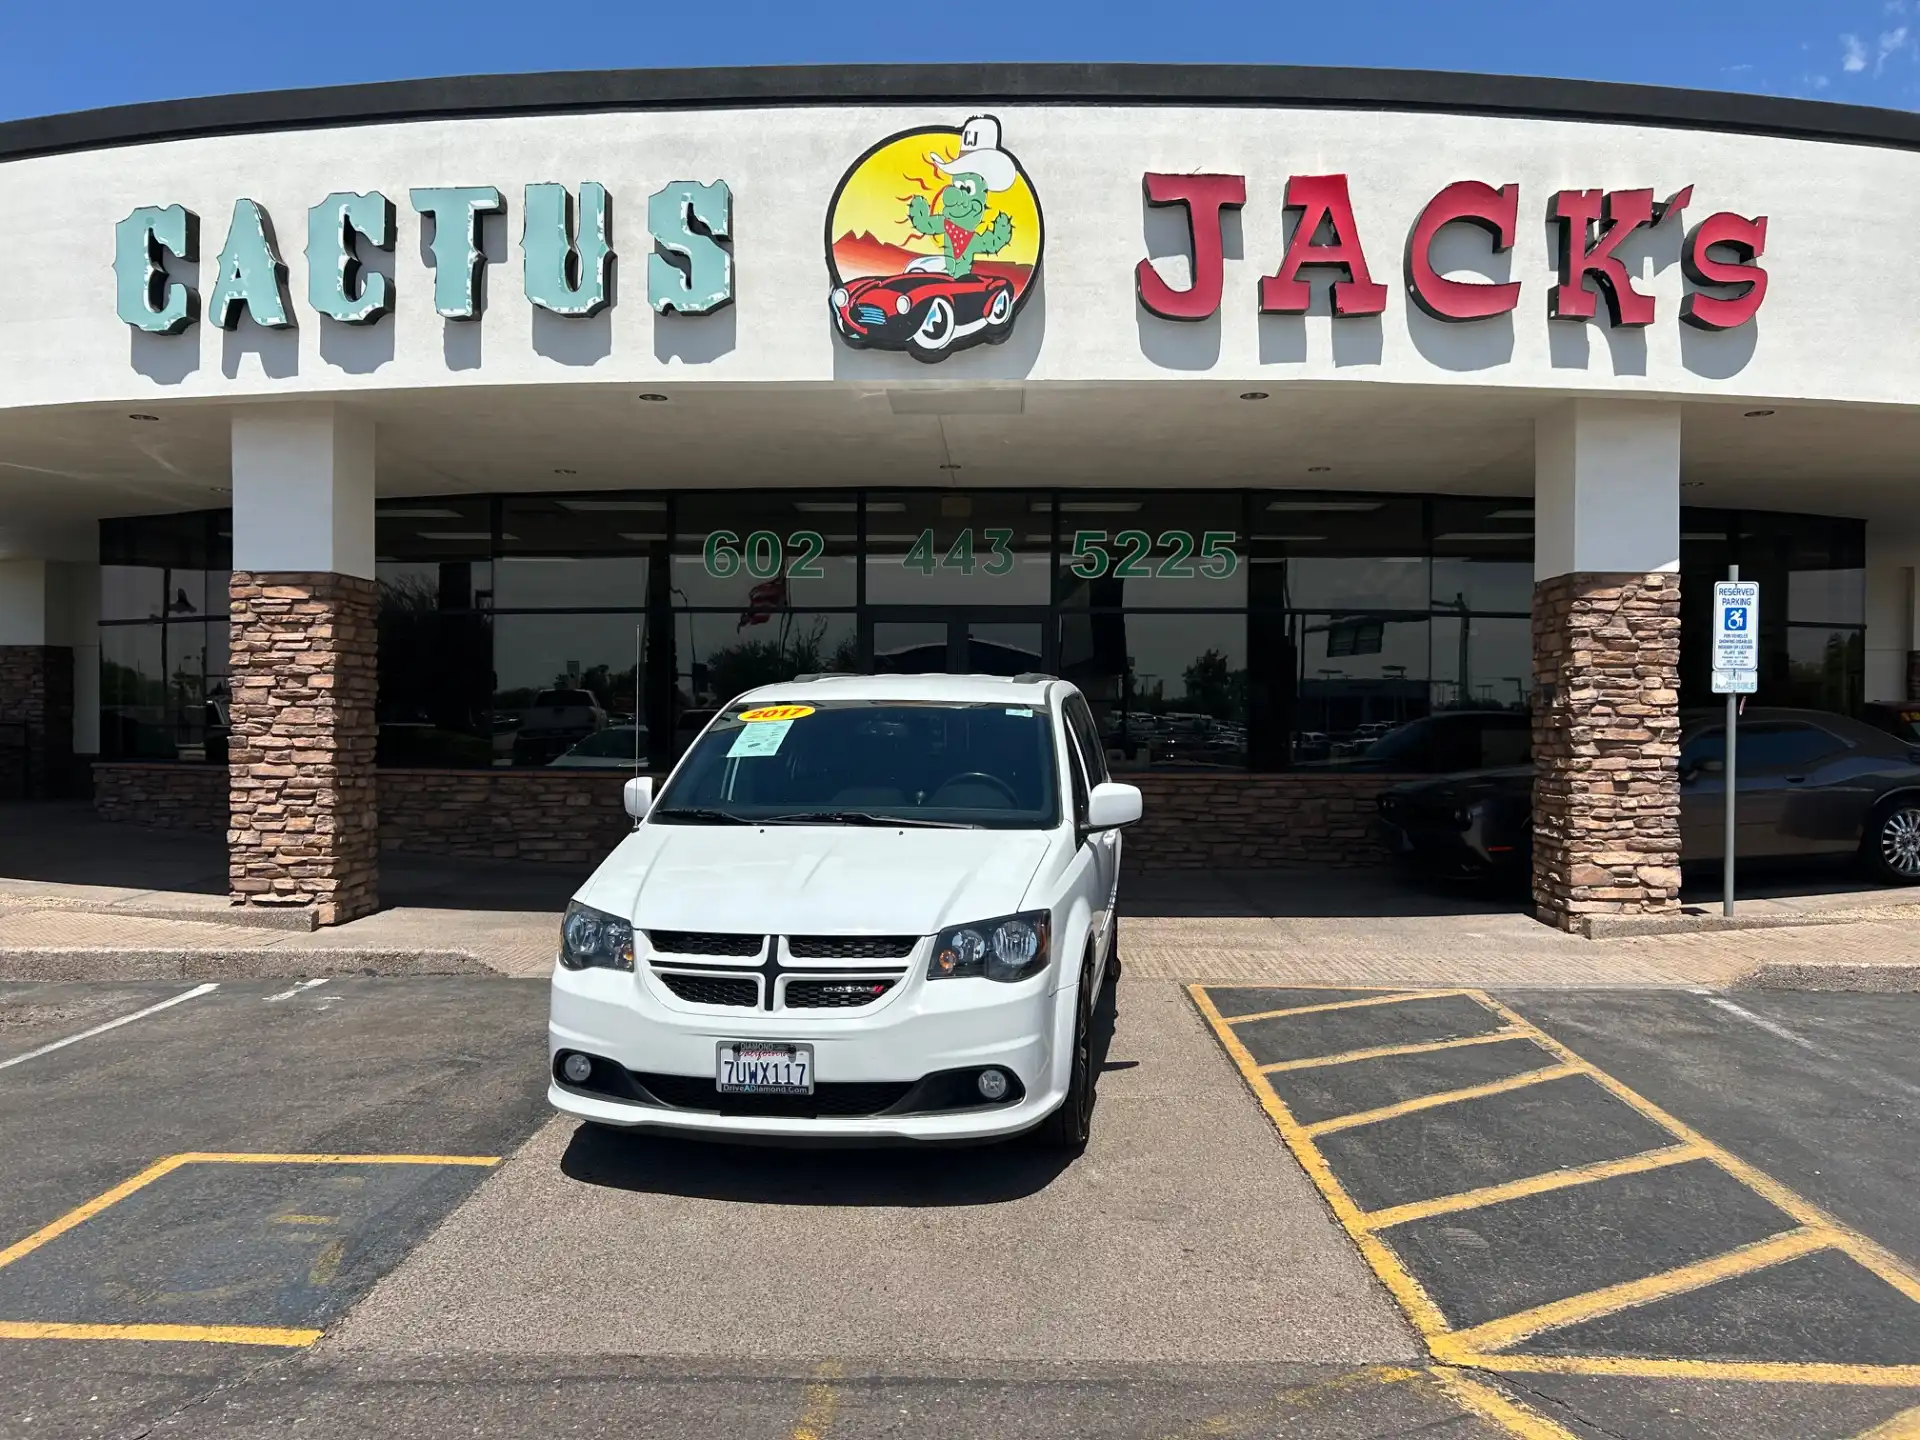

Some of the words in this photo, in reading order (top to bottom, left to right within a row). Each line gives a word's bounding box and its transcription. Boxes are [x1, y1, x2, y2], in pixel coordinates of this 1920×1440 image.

[963, 129, 979, 147] CJ
[114, 179, 735, 335] CACTUS
[702, 529, 825, 580] 602
[902, 527, 1015, 577] 443
[1070, 529, 1238, 580] 5225
[1718, 587, 1755, 596] RESERVED
[1721, 597, 1752, 606] PARKING
[747, 707, 808, 719] 2017
[724, 1060, 806, 1086] 7UWX117
